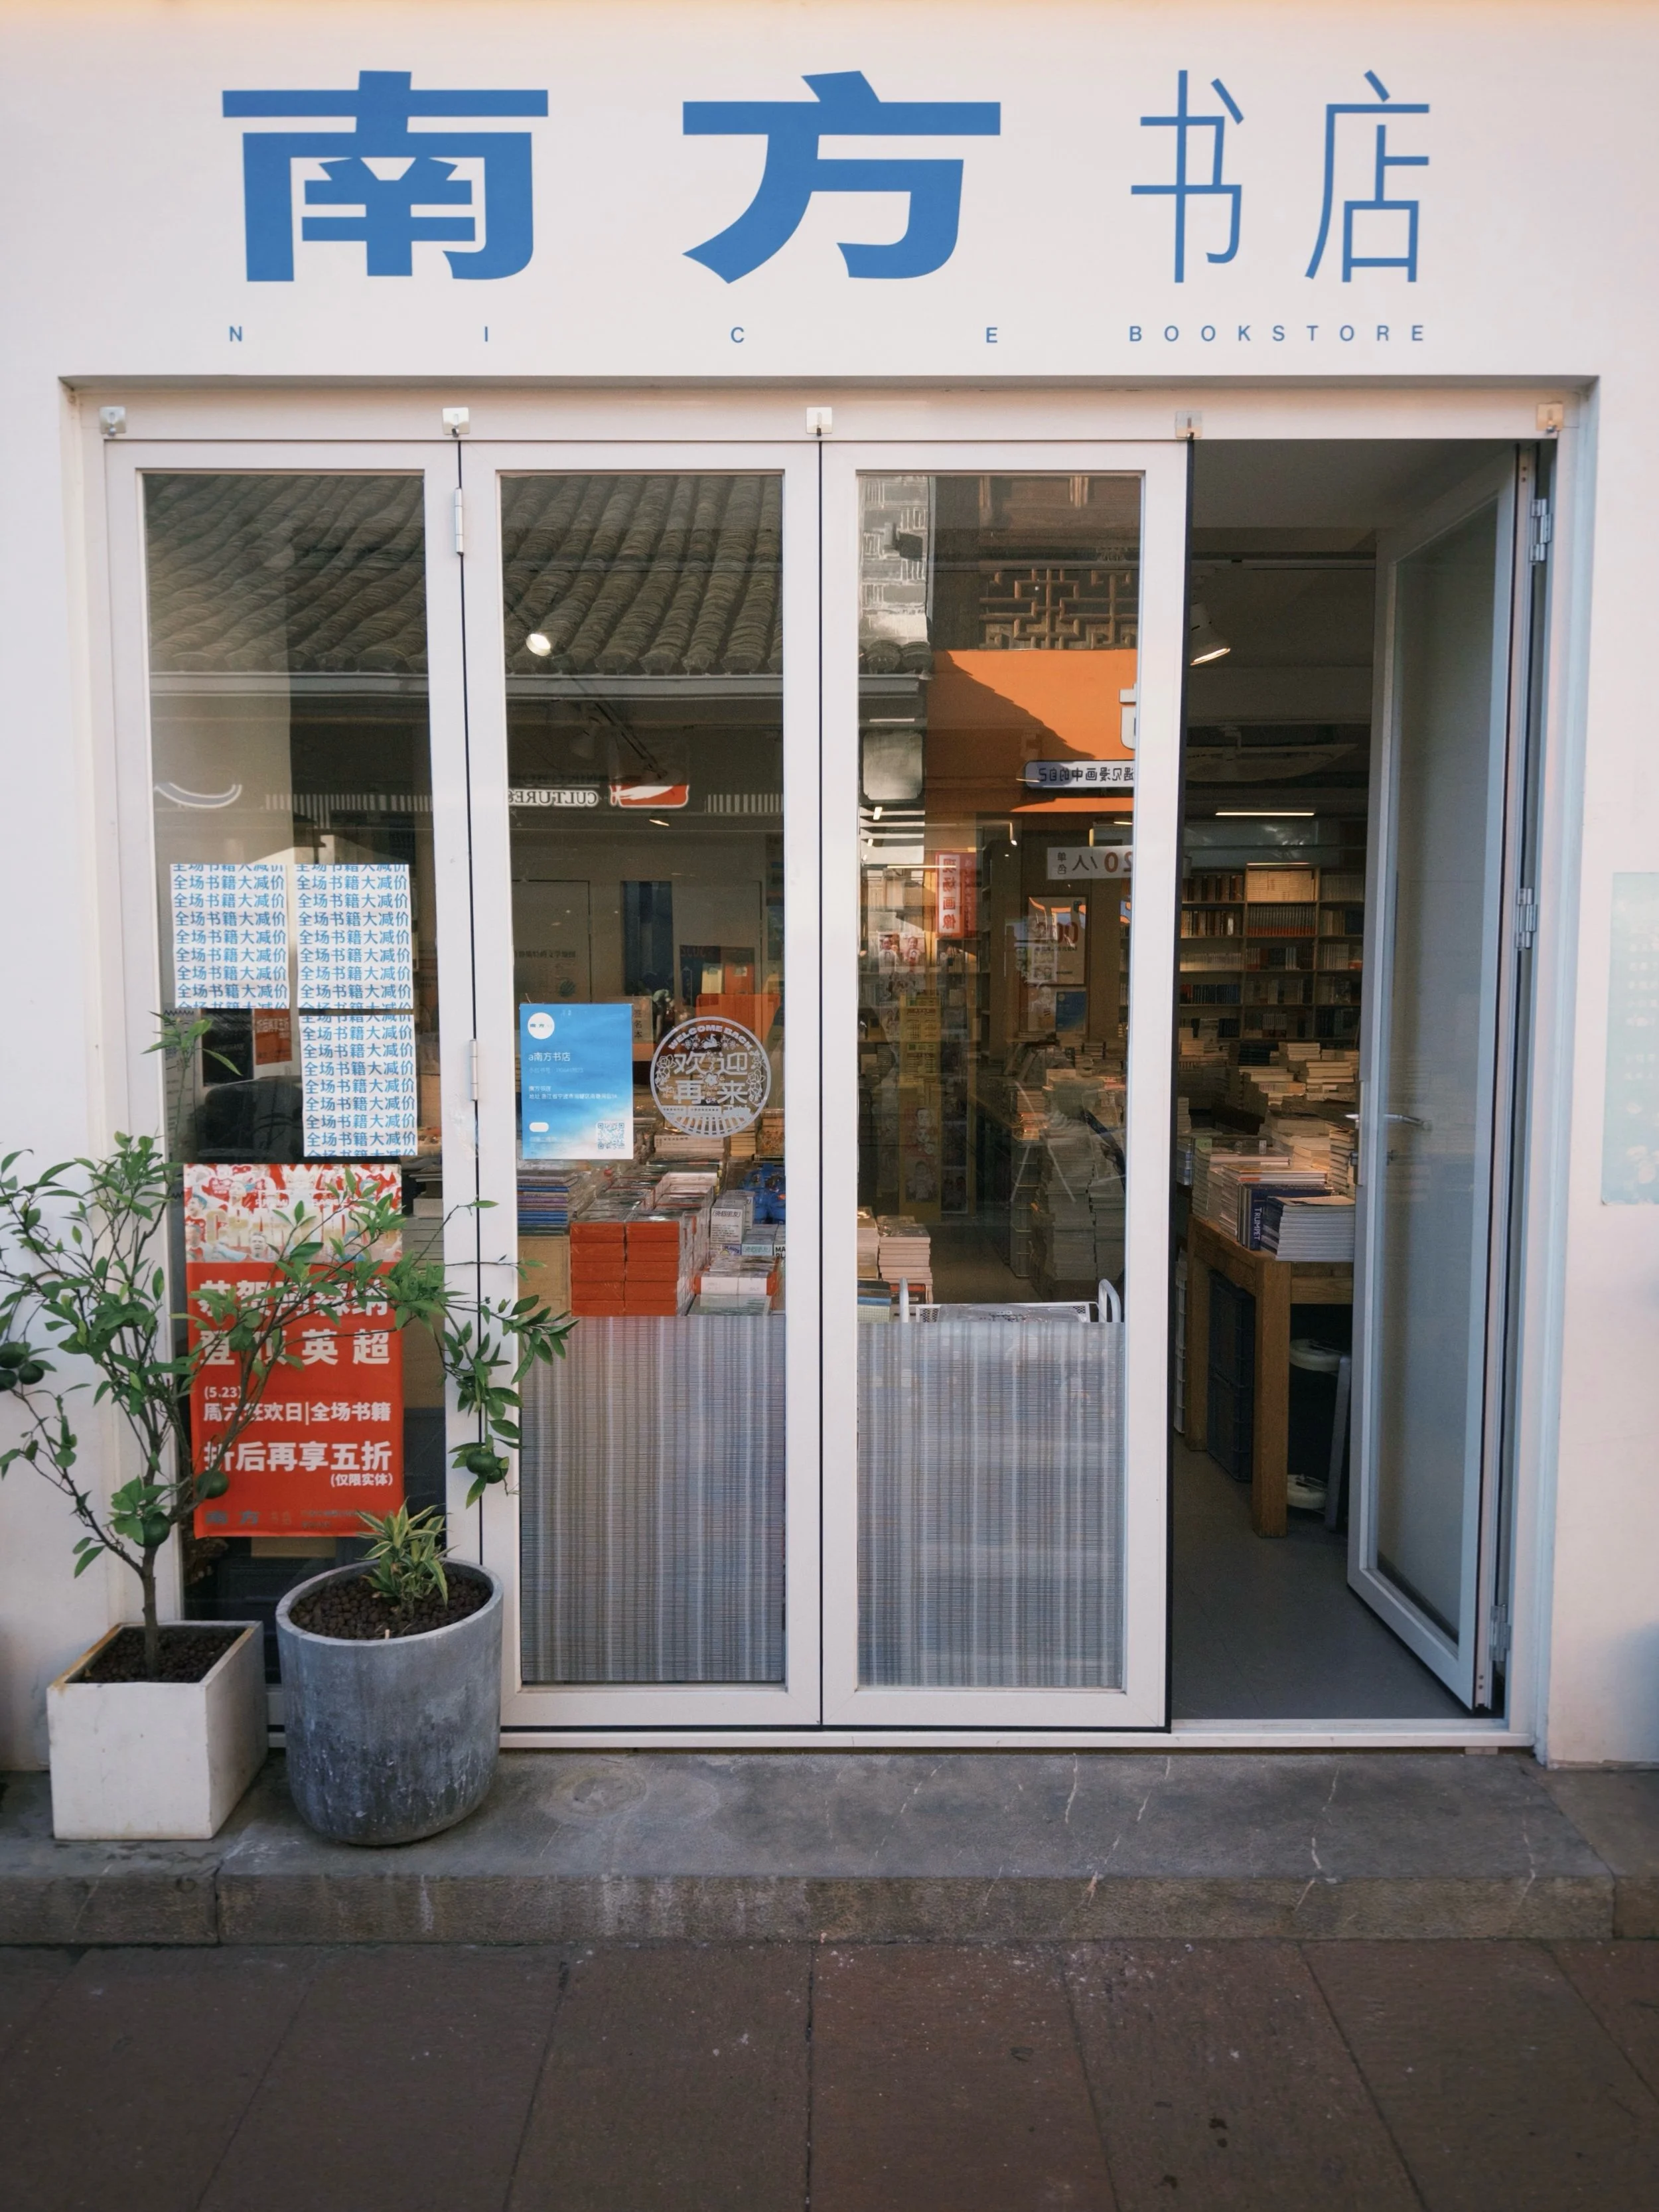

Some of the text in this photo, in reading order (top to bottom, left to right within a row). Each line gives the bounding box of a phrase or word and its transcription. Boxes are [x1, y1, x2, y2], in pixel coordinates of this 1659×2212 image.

[229, 325, 1423, 343] NICE BOOKSTORE
[174, 875, 284, 890] 全场书籍大减价
[297, 875, 407, 890] 全场书籍大减价
[175, 893, 285, 908] 全场书籍大减价
[298, 893, 407, 908] 全场书籍大减价
[175, 911, 285, 926] 全场书籍大减价
[299, 911, 408, 926] 全场书籍大减价
[176, 929, 285, 944] 全场书籍大减价
[299, 929, 409, 944] 全场书籍大减价
[177, 948, 286, 962] 全场书籍大减价
[299, 948, 410, 962] 全场书籍大减价
[177, 965, 287, 980] 全场书籍大减价
[300, 965, 411, 980] 全场书籍大减价
[178, 984, 287, 999] 全场书籍大减价
[300, 984, 411, 999] 全场书籍大减价
[303, 1026, 412, 1041] 全场书籍大减价
[668, 1024, 753, 1051] WELCOME BACK
[303, 1043, 413, 1058] 全场书籍大减价
[528, 1052, 571, 1062] a南方书店
[304, 1061, 413, 1075] 全场书籍大减价
[673, 1051, 748, 1075] 欢迎
[305, 1078, 414, 1094] 全场书籍大减价
[673, 1080, 749, 1104] 再来
[306, 1096, 415, 1111] 全场书籍大减价
[307, 1114, 415, 1128] 全场书籍大减价
[308, 1132, 416, 1147] 全场书籍大减价
[204, 1386, 242, 1400] (5.23)
[204, 1441, 392, 1471] 折后再享五折
